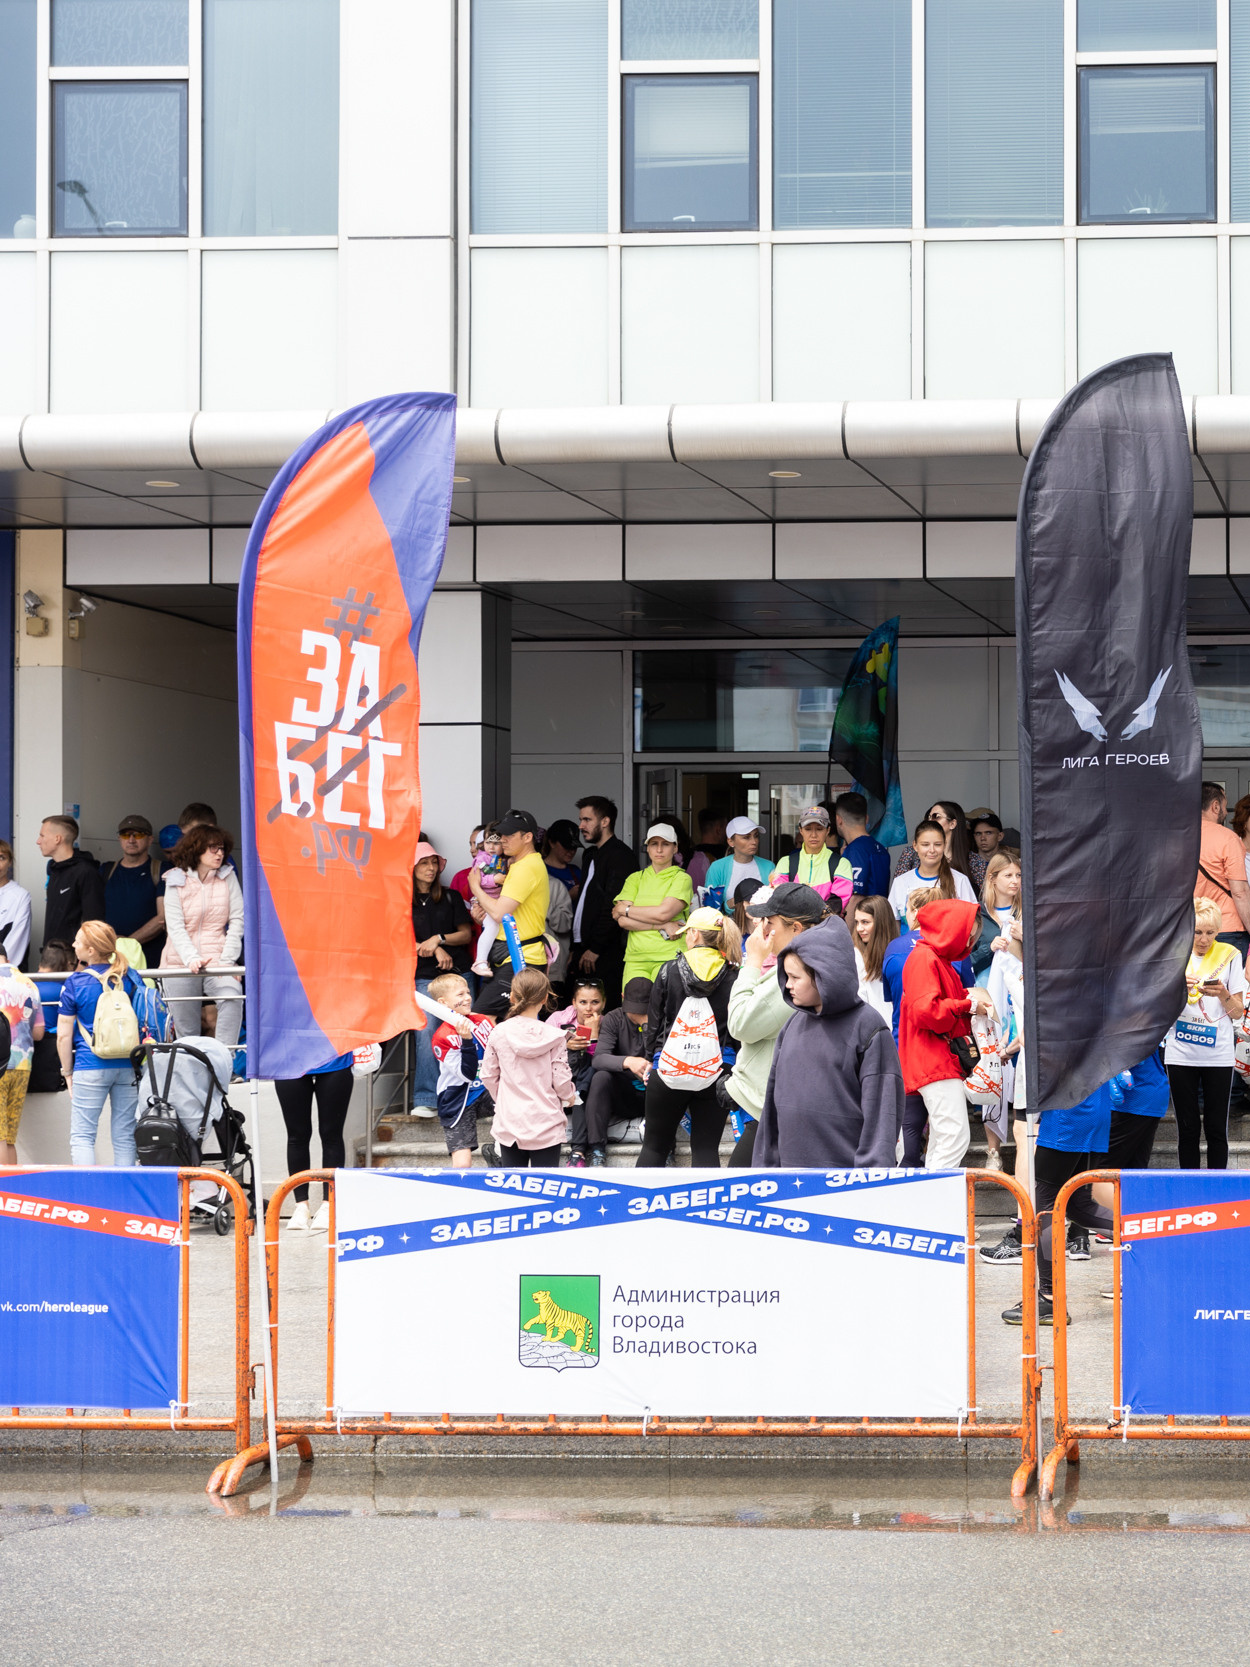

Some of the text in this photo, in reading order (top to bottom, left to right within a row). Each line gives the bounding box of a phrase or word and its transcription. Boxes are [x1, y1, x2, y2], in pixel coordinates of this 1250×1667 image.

[1062, 753, 1170, 769] ЛИГА ГЕРОЕВ
[1176, 1031, 1215, 1045] 00509
[628, 1180, 778, 1215] ЗАБЕГ.РФ
[430, 1207, 581, 1243] ЗАБЕГ.РФ
[1121, 1211, 1217, 1236] БЕГ.РФ
[612, 1285, 780, 1307] Администрация
[0, 1301, 109, 1315] vk.com/heroleague
[612, 1315, 684, 1332] города
[612, 1336, 757, 1357] Владивостока
